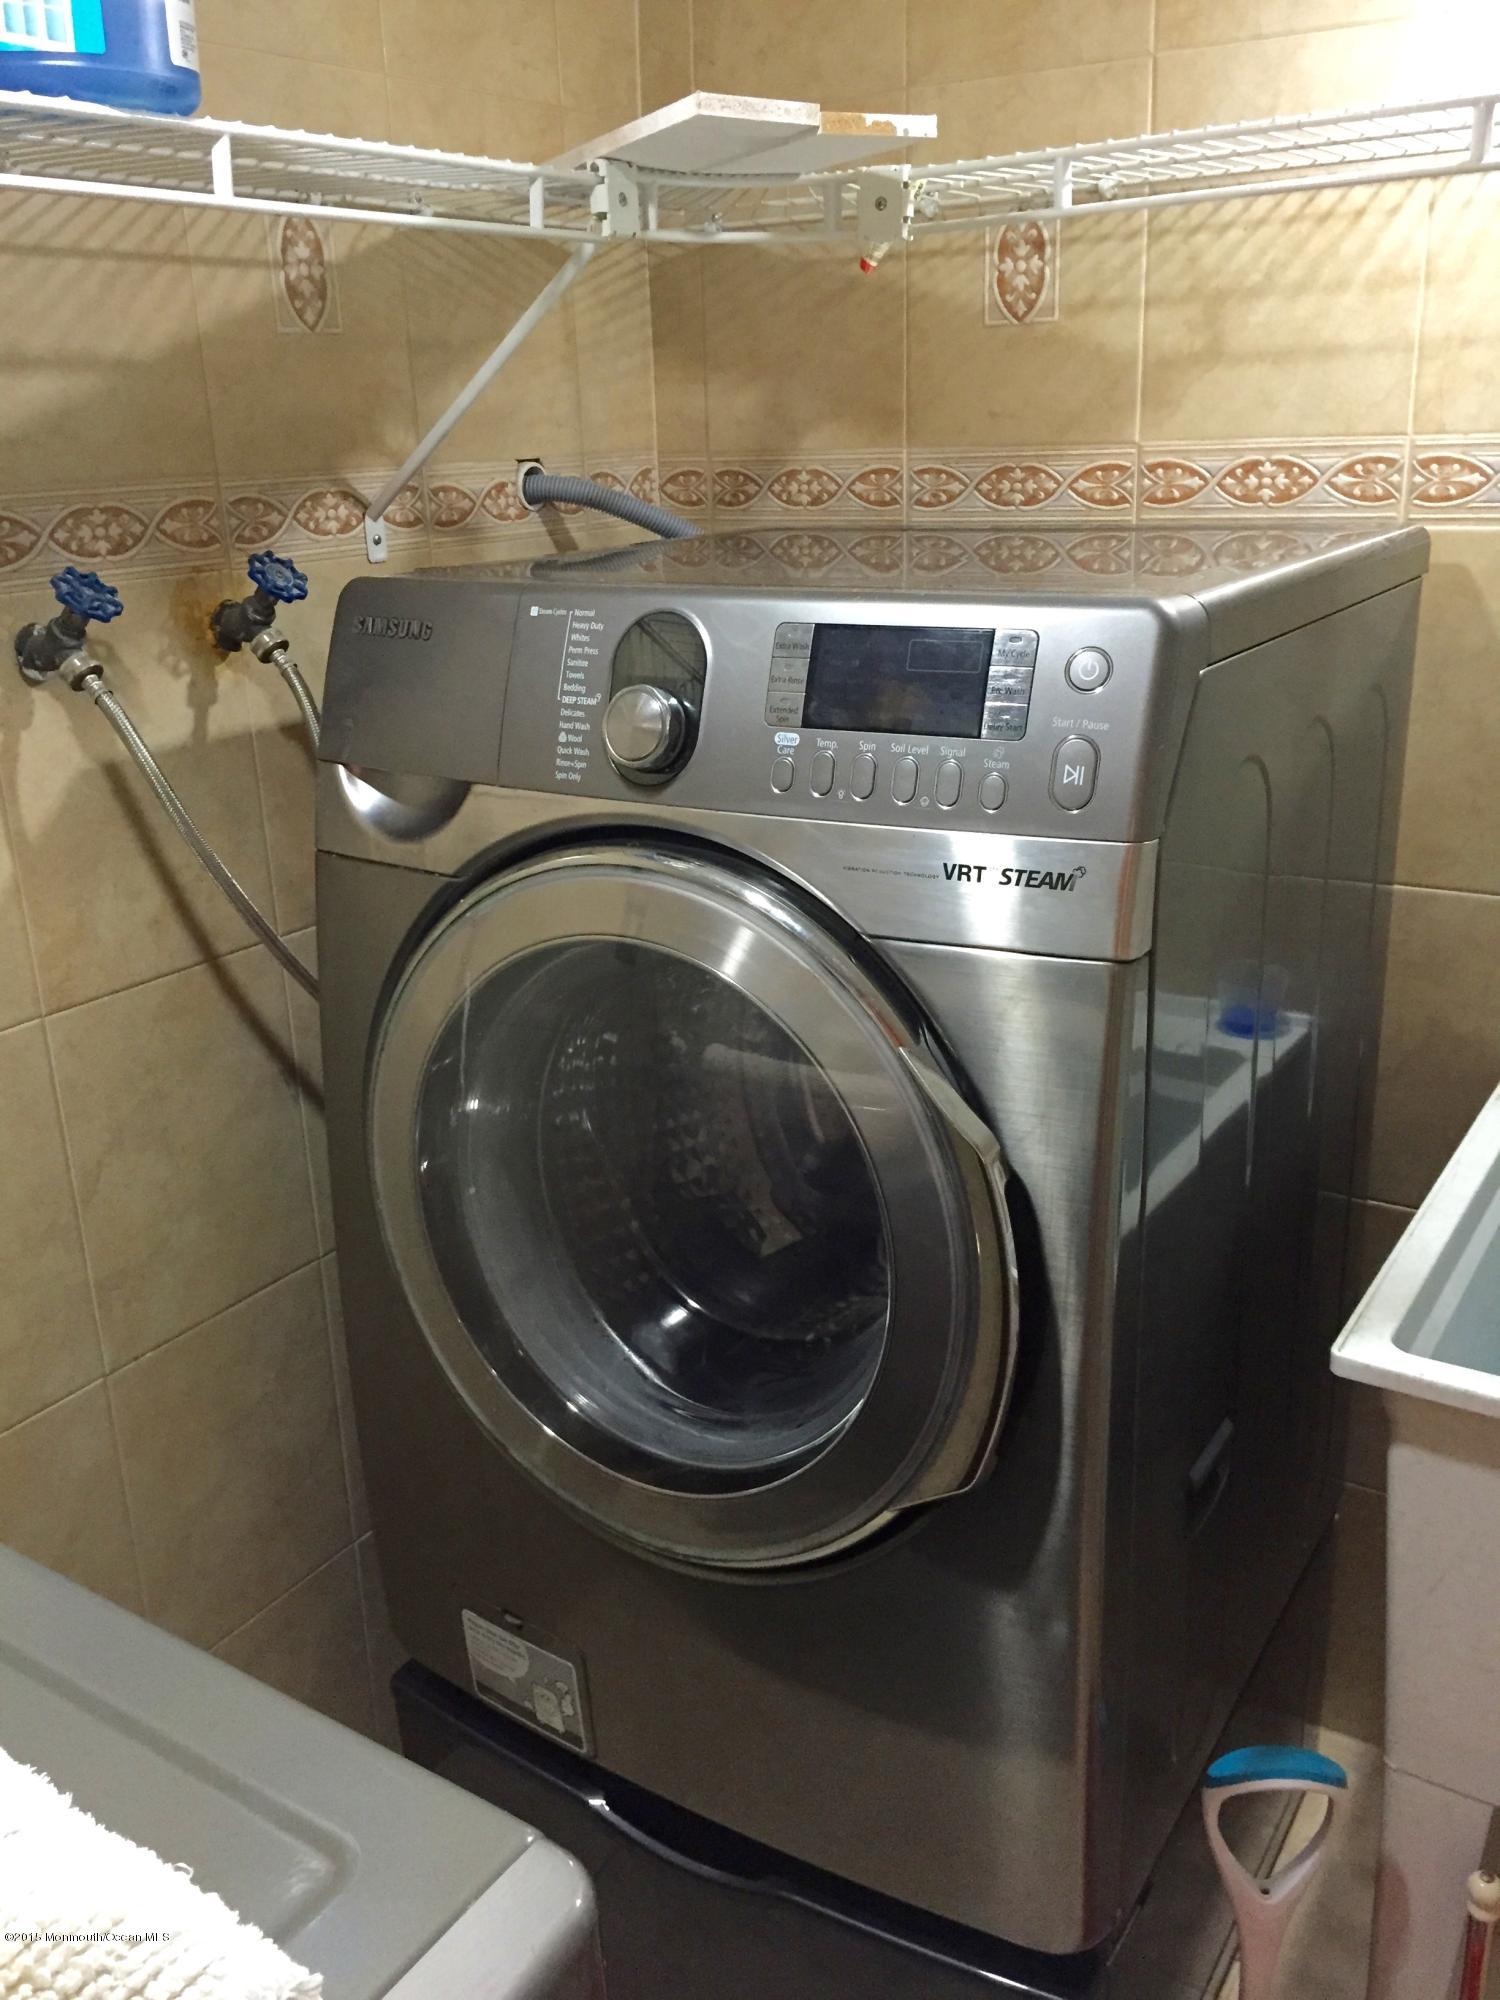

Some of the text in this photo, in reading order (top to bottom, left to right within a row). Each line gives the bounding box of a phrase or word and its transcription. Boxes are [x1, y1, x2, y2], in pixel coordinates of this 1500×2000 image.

[574, 609, 596, 617] Normal
[352, 616, 433, 641] SAMSUNG
[572, 621, 604, 632] Heavy Duty
[571, 633, 590, 642] Whites
[584, 646, 599, 655] Press
[567, 658, 589, 667] Sanitize
[566, 670, 585, 680] Towels
[563, 683, 586, 694] Bedding
[562, 695, 597, 706] DEEP STEAM
[560, 708, 585, 718] Delicates
[559, 720, 591, 731] Hand Wash
[1052, 716, 1074, 727] Start
[1082, 718, 1110, 731] Pause
[568, 734, 583, 743] Wool
[777, 733, 798, 745] Silver
[815, 737, 839, 750] Temp.
[557, 746, 590, 757] Quick Wash
[777, 745, 795, 755] Care
[859, 740, 876, 753] Spin
[891, 742, 929, 755] Soil Level
[940, 745, 966, 759] Signal
[983, 758, 1010, 769] Steam
[555, 770, 582, 783] Spin Only
[943, 862, 1078, 892] VRT STEAM
